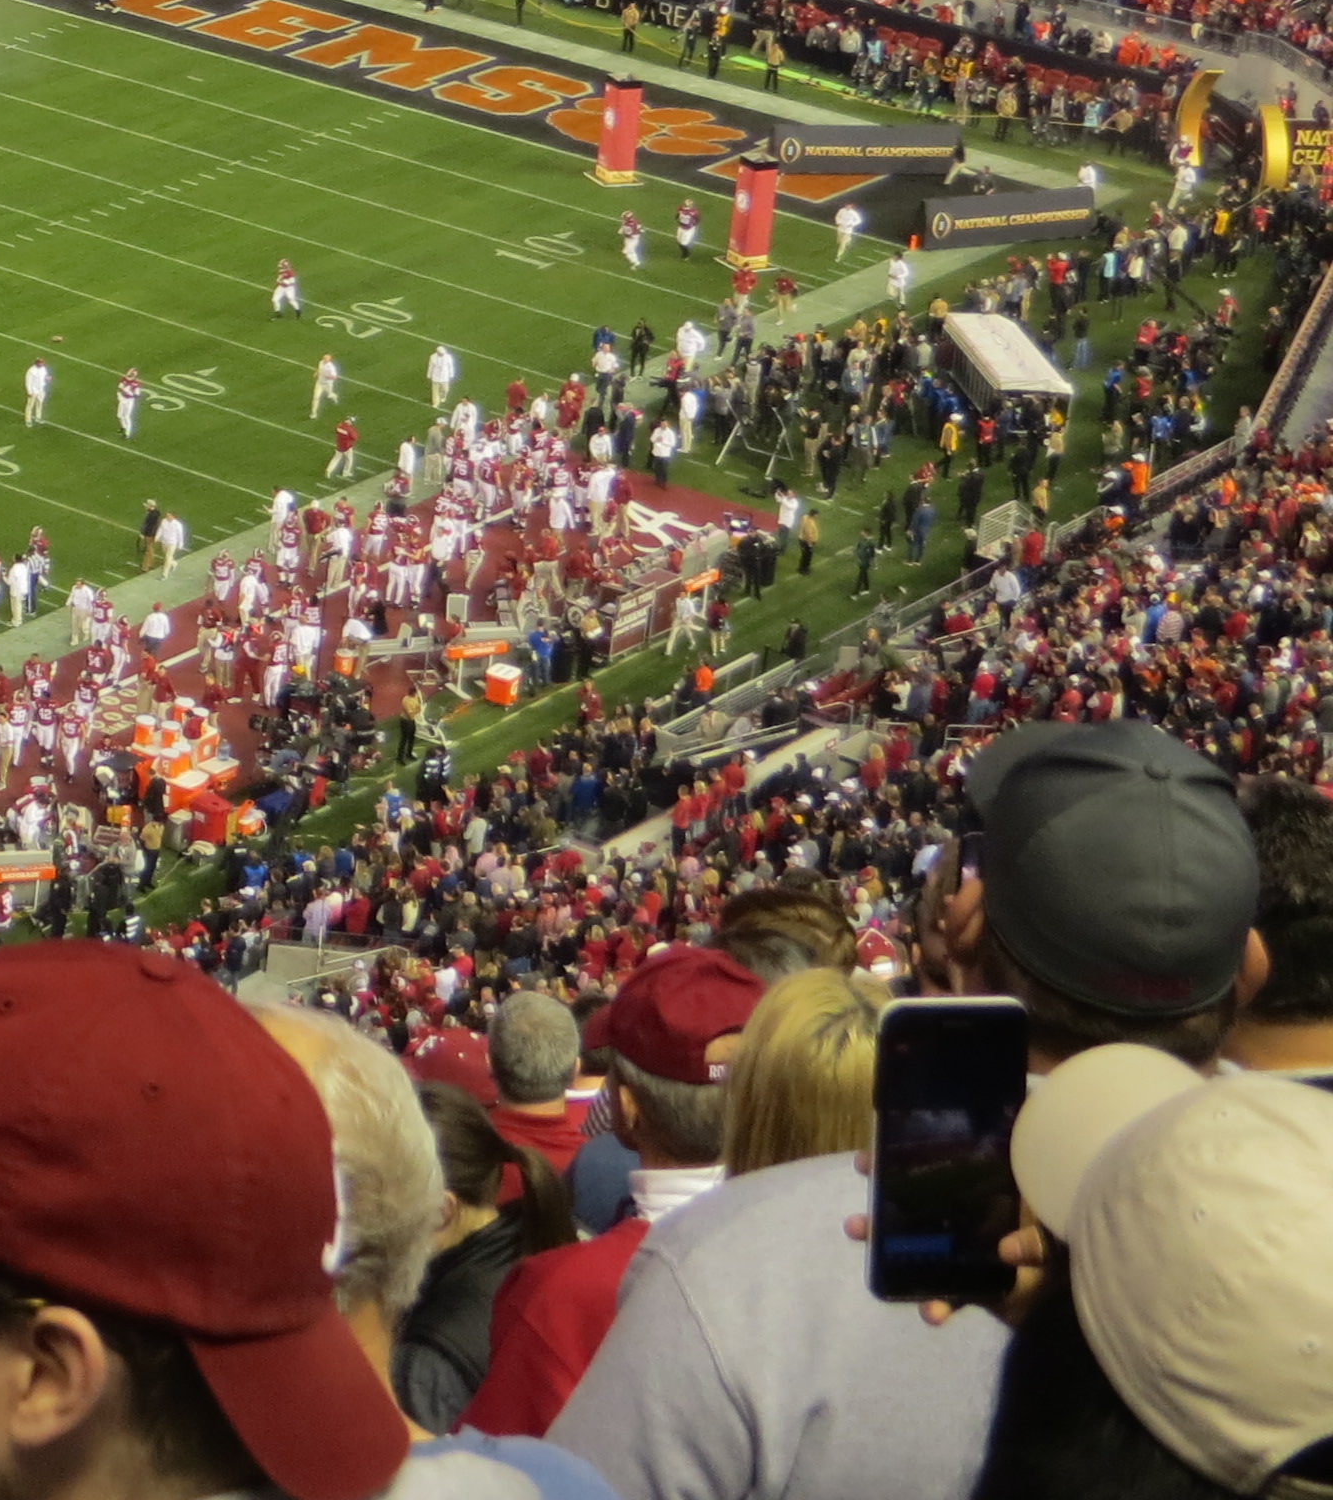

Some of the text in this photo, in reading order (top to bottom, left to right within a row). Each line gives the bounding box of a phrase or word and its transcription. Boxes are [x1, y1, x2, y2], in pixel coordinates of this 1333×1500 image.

[805, 145, 864, 158] NATIONAL
[953, 208, 1090, 231] NATIONAL CHAMPIONSHIP
[495, 233, 584, 270] 10
[317, 301, 414, 339] 20
[139, 373, 224, 413] 30
